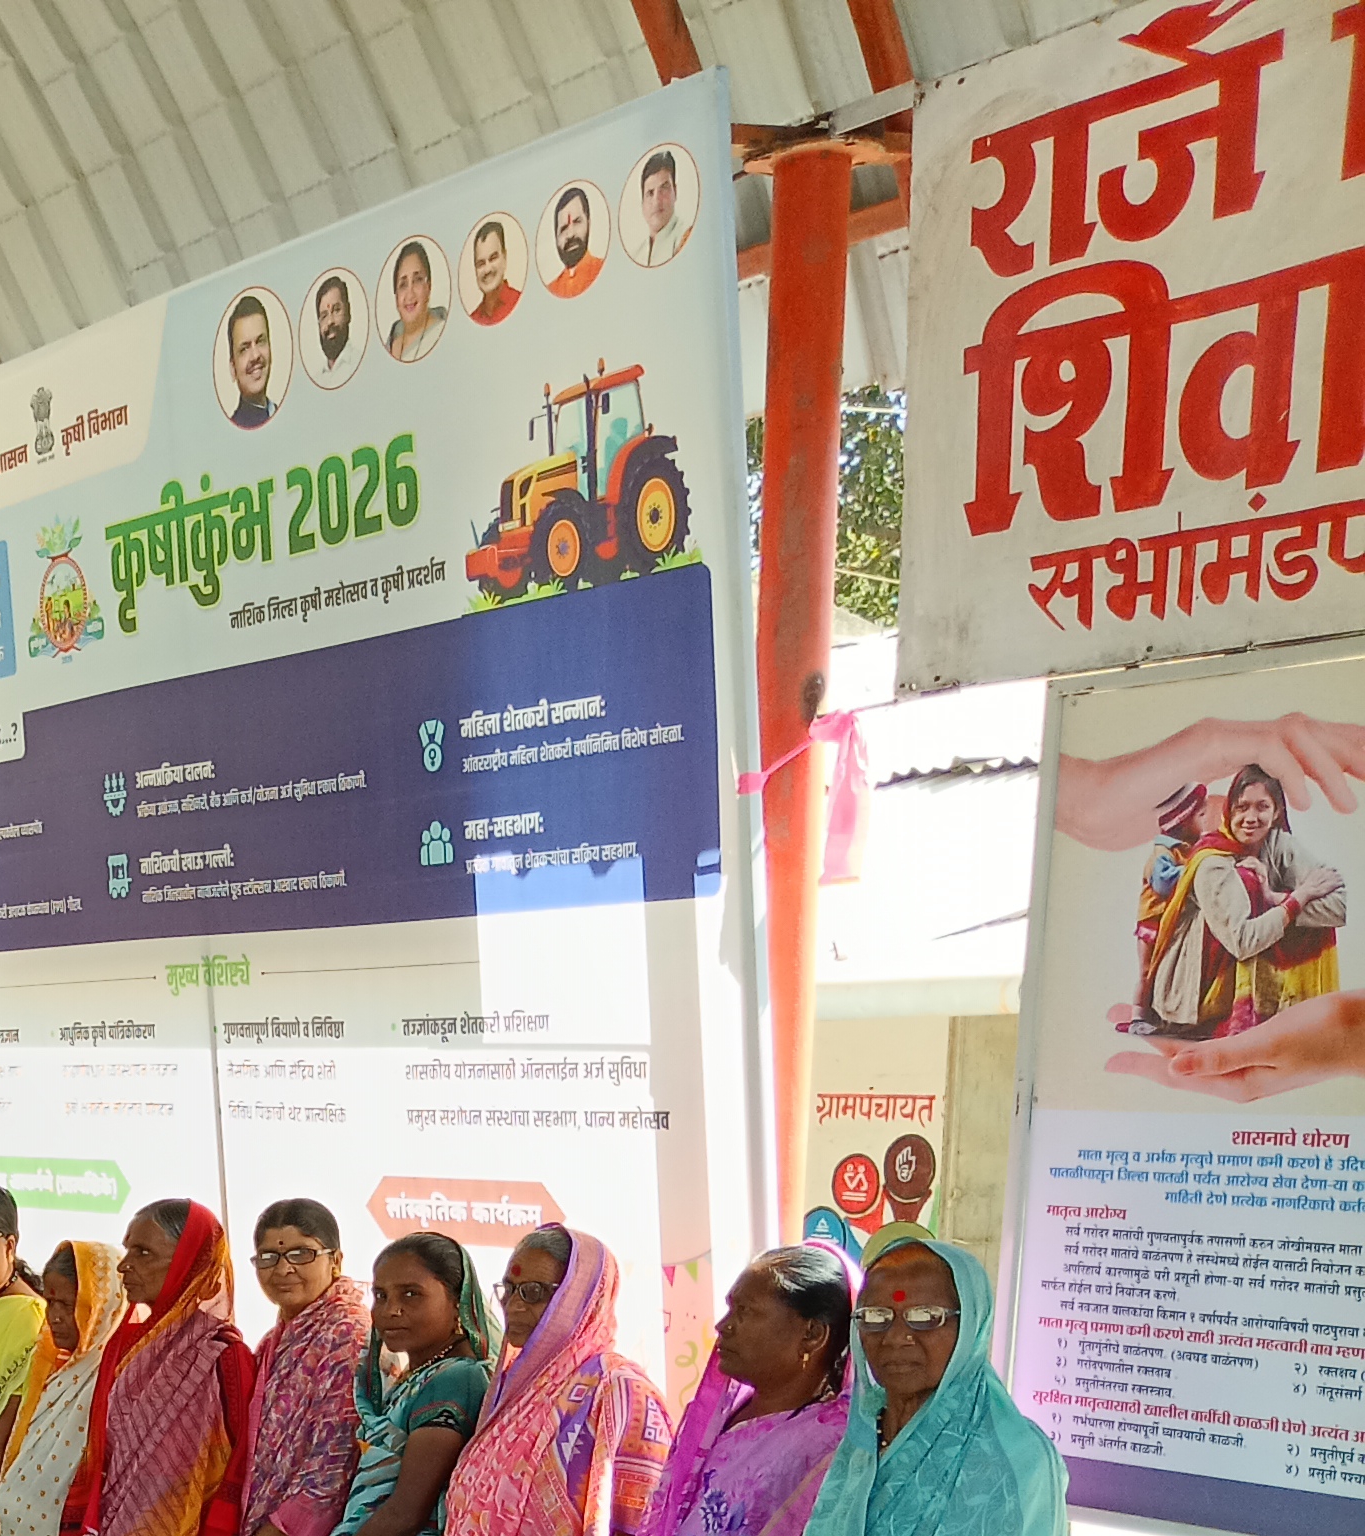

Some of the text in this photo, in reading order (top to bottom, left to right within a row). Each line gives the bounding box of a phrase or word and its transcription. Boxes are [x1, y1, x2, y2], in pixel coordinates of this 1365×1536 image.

[971, 0, 1283, 277] राजे
[61, 405, 128, 456] कृषी विभाग
[104, 432, 420, 634] कृषीकुंभ 2026
[229, 602, 265, 629] नाशिक
[268, 596, 297, 621] जिल्हा
[300, 587, 322, 623] कृषी
[380, 565, 404, 604] कृषी
[407, 557, 446, 588] प्रदर्शन
[459, 695, 606, 738] महिला शेतकरी सन्मान:
[509, 745, 538, 766] महिला
[540, 738, 572, 762] शेतकरी
[621, 726, 647, 749] विशेष
[464, 812, 544, 840] महा-सहभाग:
[165, 963, 199, 996] मुख्य
[91, 1021, 106, 1047] कृषी
[271, 1016, 300, 1038] बियाणे
[303, 1022, 309, 1038] व
[460, 1011, 500, 1034] शेतकरी
[583, 1057, 604, 1079] अर्ज
[608, 1056, 647, 1086] सुविधा
[619, 1107, 670, 1130] महोत्सव
[817, 1086, 935, 1127] ग्रामपंचायत
[1232, 1128, 1350, 1148] शासनाचे धोरण
[1078, 1149, 1101, 1161] माता
[1133, 1152, 1140, 1162] व
[1257, 1153, 1283, 1168] कमी
[1287, 1155, 1320, 1169] करणे
[1324, 1155, 1333, 1170] हे
[1118, 1167, 1149, 1182] जिल्हा
[1153, 1170, 1188, 1184] पातळी
[1225, 1172, 1268, 1187] आरोग्य
[1273, 1174, 1296, 1189] सेवा
[1046, 1204, 1126, 1220] मातृत्व आरोग्य
[1207, 1191, 1227, 1206] देणे
[1231, 1192, 1267, 1207] प्रत्येक
[1033, 1389, 1072, 1405] सुरक्षित
[1144, 1404, 1188, 1420] खालील
[1234, 1416, 1279, 1432] काळजी
[1282, 1419, 1306, 1436] घेणे
[1309, 1425, 1349, 1442] अत्यंत
